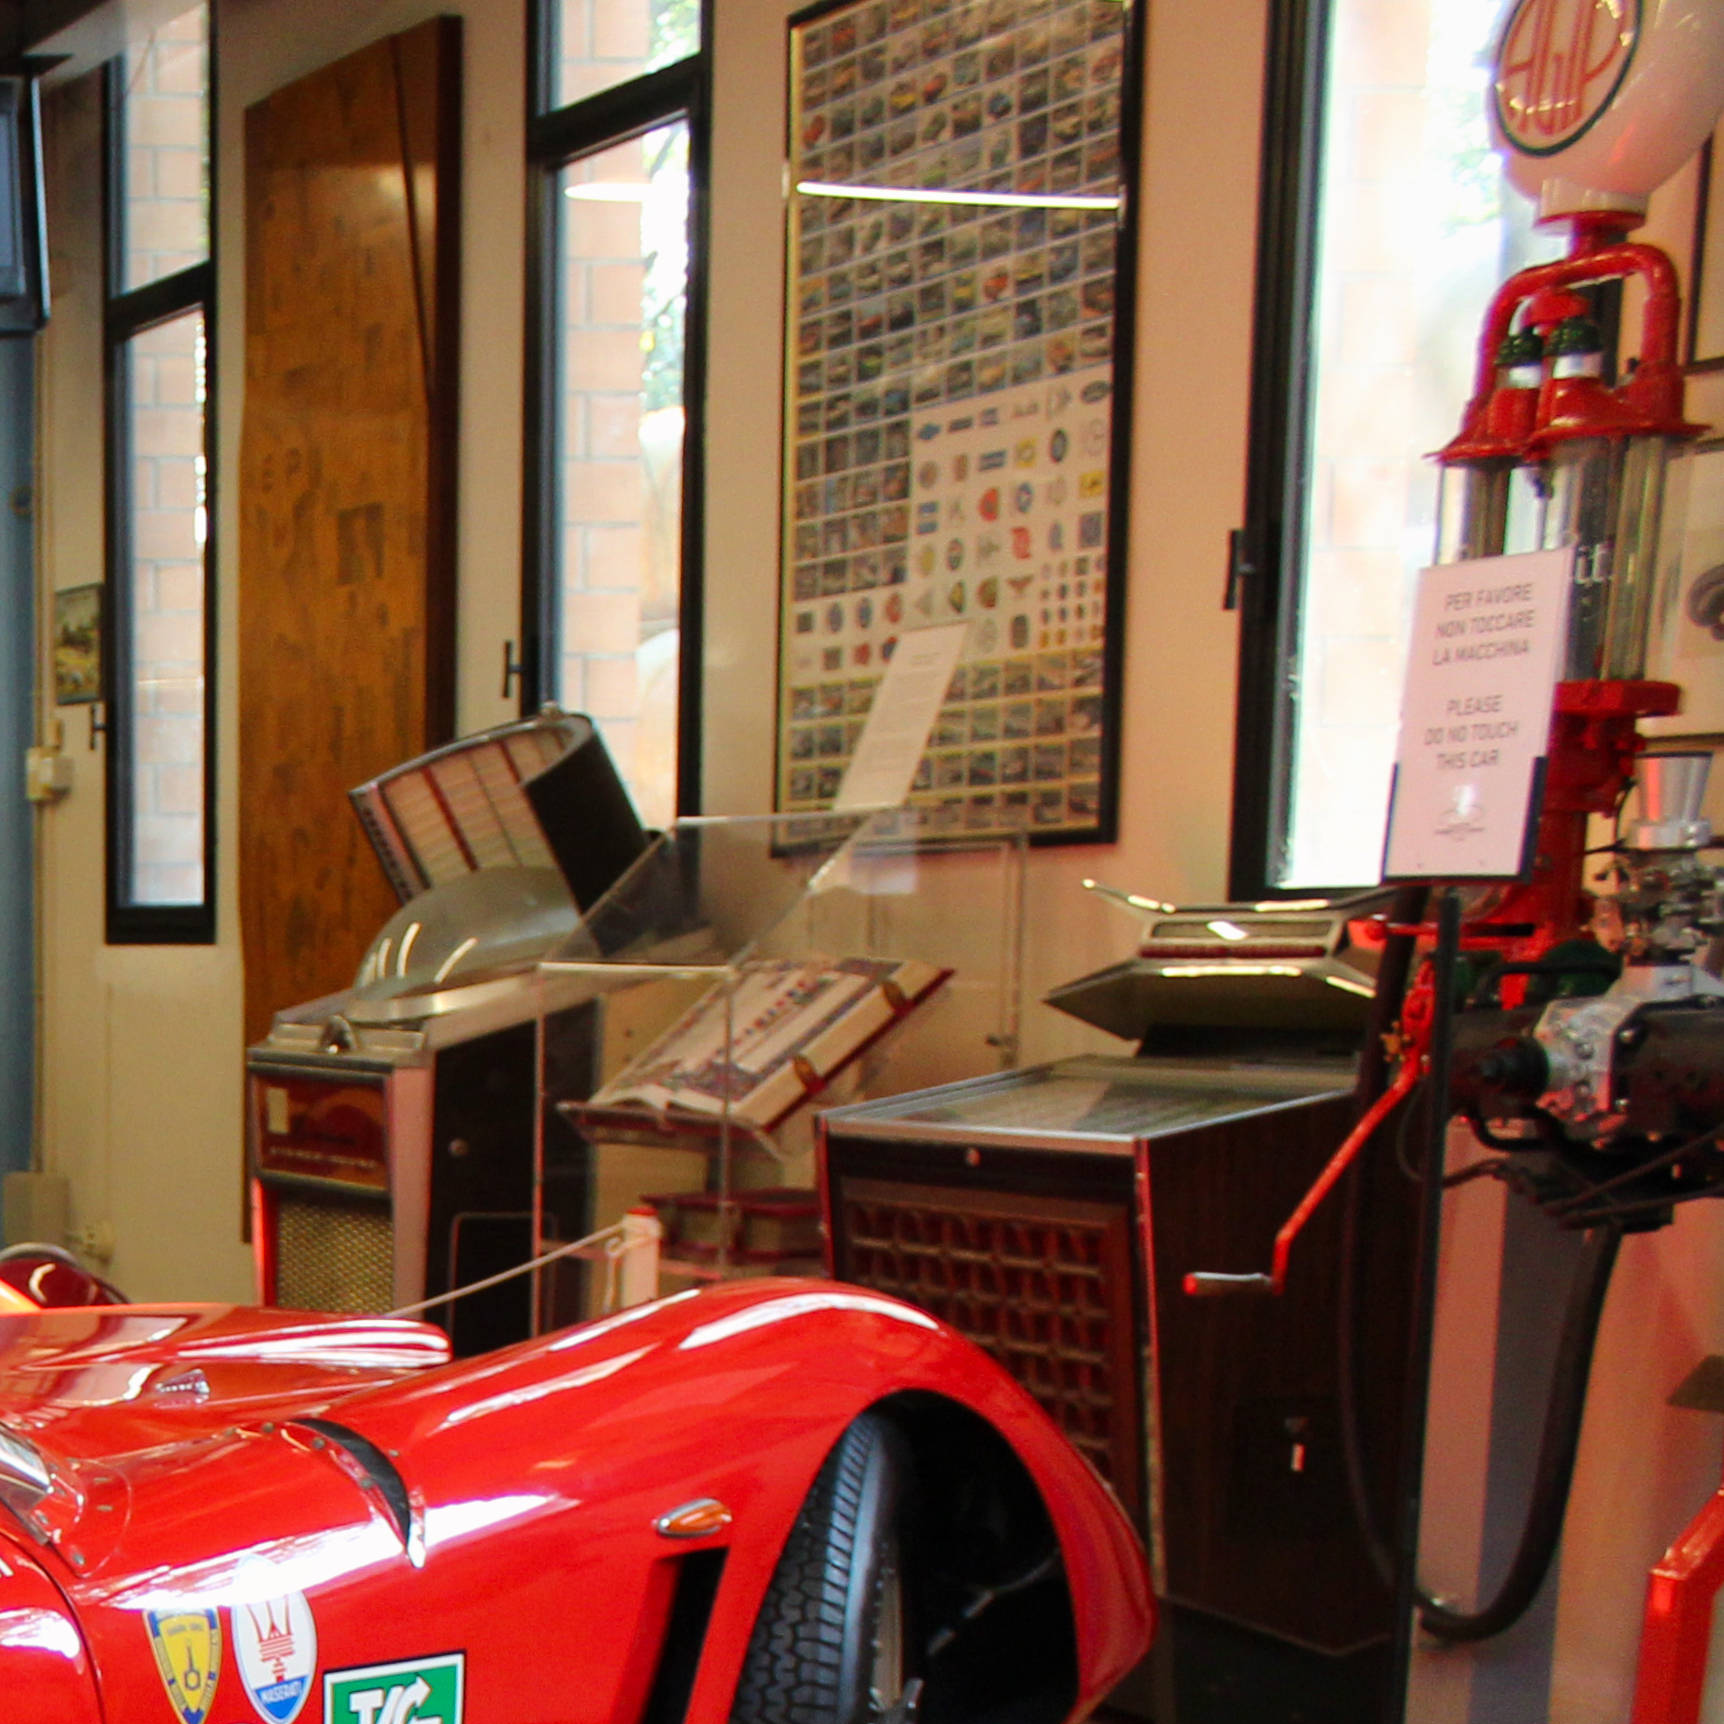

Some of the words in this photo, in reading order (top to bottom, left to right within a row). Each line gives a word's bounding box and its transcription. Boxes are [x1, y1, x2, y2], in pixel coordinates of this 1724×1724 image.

[1445, 591, 1473, 611] PER
[1476, 583, 1534, 604] FAVORE
[1436, 620, 1467, 638] NON
[1471, 609, 1536, 634] TOCCARE
[1432, 648, 1451, 666] LA
[1455, 639, 1530, 661] MACCHINA
[1447, 695, 1503, 716] PLEASE
[1424, 727, 1444, 745] DO
[1448, 725, 1468, 743] NO
[1471, 721, 1520, 741] TOUCH
[1437, 752, 1467, 770] THIS
[1470, 748, 1500, 767] CAR
[259, 1679, 303, 1704] MASERATI
